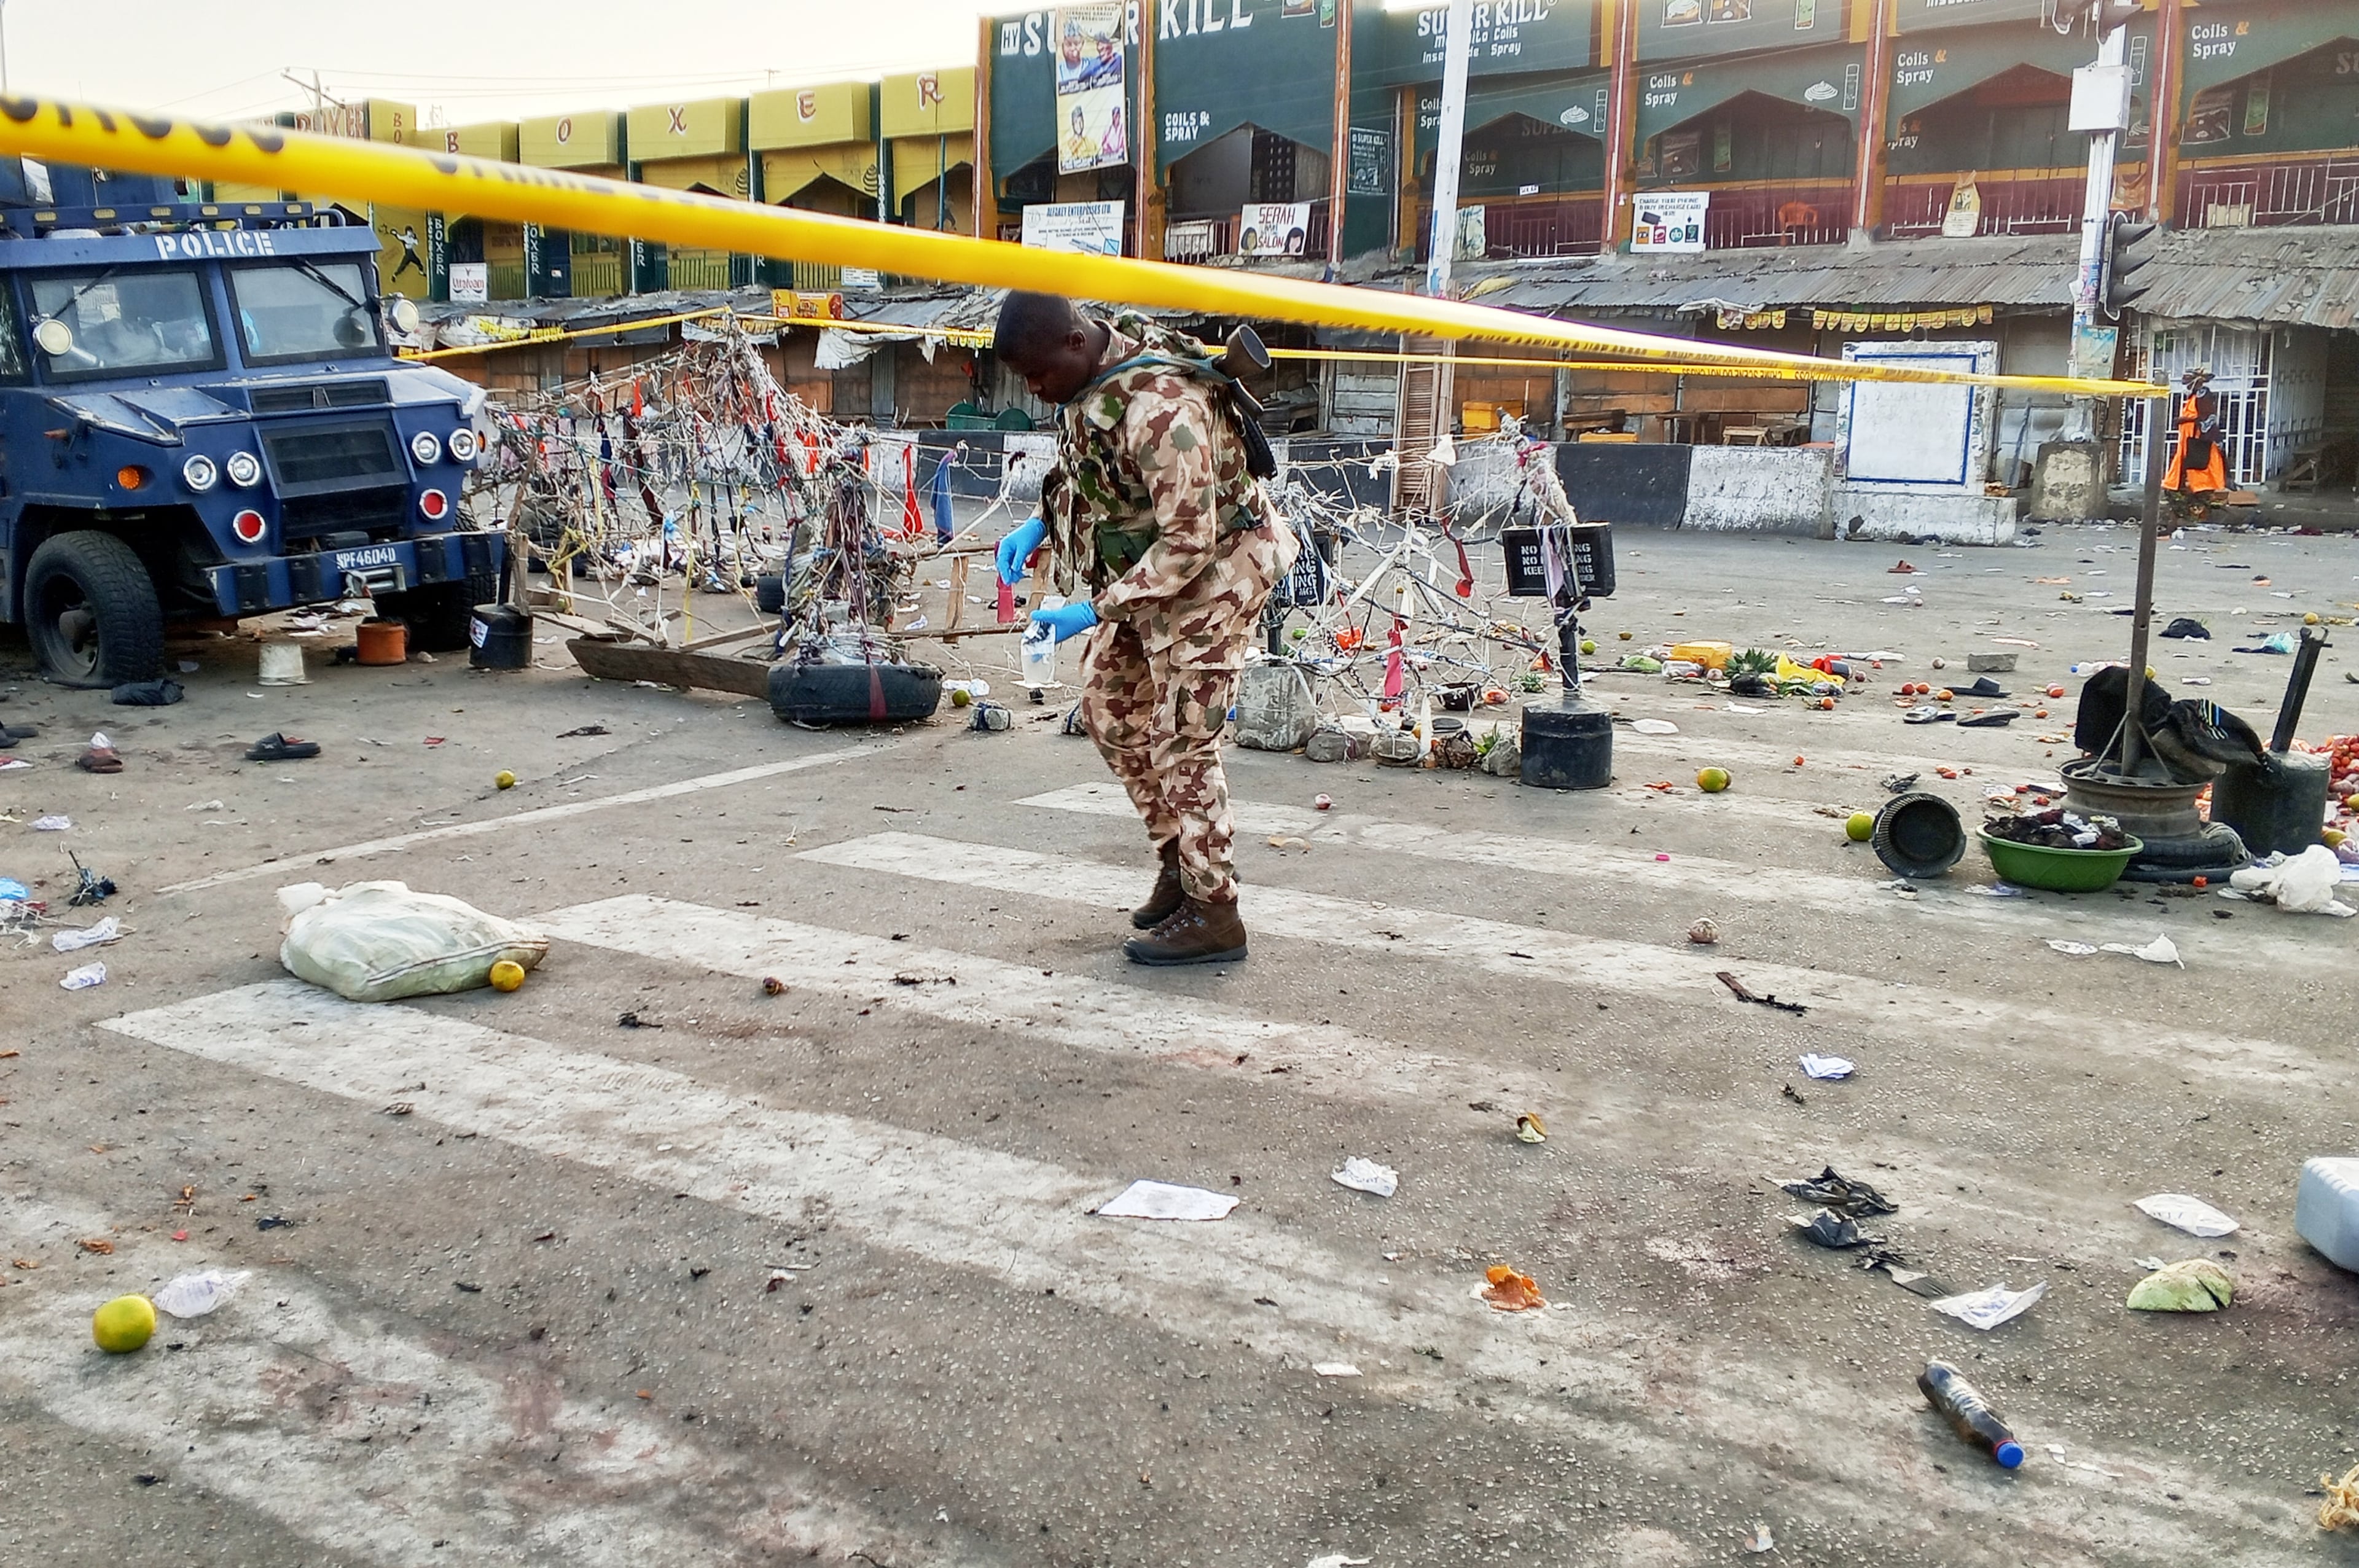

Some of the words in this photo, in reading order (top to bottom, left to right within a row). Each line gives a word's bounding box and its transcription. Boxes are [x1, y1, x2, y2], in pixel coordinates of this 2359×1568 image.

[1495, 0, 1549, 26] KILL
[1493, 25, 1519, 41] Coils
[2191, 23, 2229, 40] Coils
[2235, 21, 2250, 36] &
[1490, 42, 1522, 57] Spray
[2193, 41, 2237, 60] Spray
[1897, 52, 1929, 67] Coils
[1935, 49, 1947, 63] &
[1649, 74, 1677, 89] Coils
[1896, 69, 1934, 86] Spray
[1645, 92, 1678, 108] Spray
[1165, 112, 1197, 127] COILS
[1200, 111, 1210, 127] &
[1165, 125, 1199, 141] SPRAY
[1469, 163, 1496, 176] Spray
[155, 231, 275, 260] POLICE
[1520, 545, 1538, 555] NO
[1522, 556, 1538, 566] NO
[1523, 566, 1544, 576] KEE
